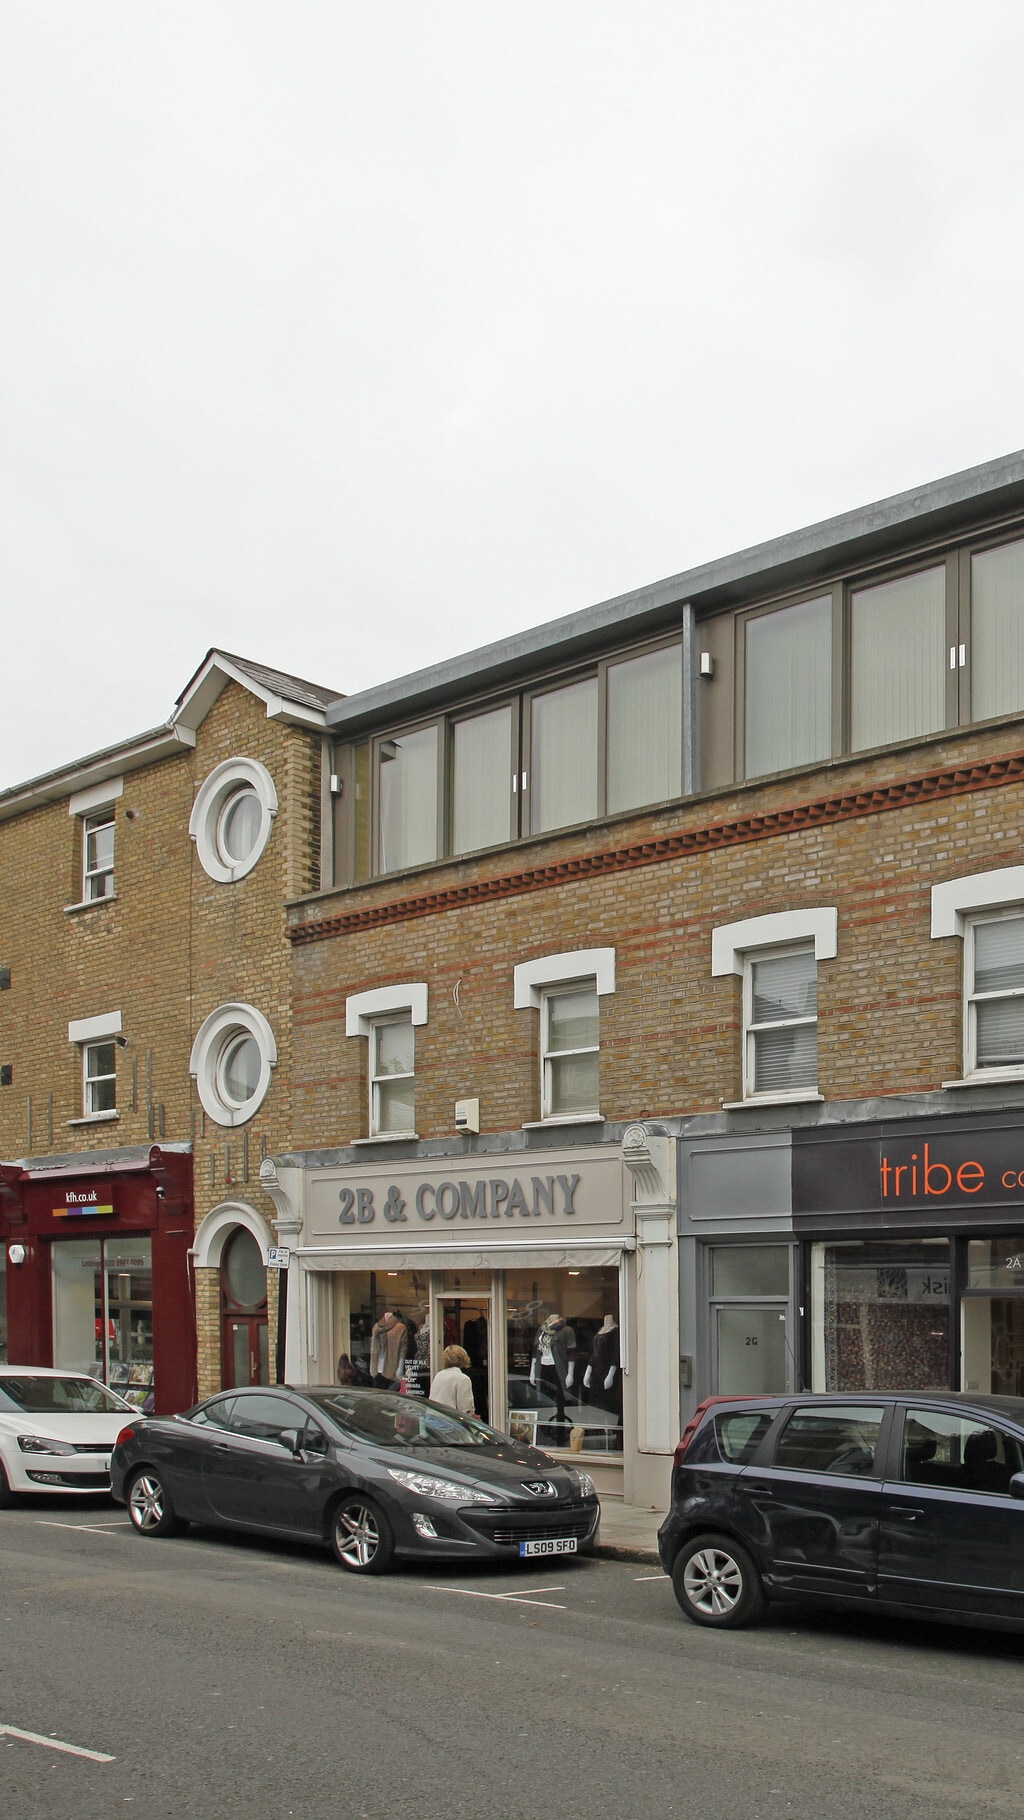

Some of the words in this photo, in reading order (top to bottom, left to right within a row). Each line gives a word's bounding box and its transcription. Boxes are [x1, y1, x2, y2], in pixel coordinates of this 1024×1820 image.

[880, 1143, 985, 1197] tribe
[65, 1190, 98, 1203] kfh.co.uk
[339, 1187, 375, 1224] 2B
[383, 1185, 408, 1222] &
[415, 1174, 581, 1220] COMPANY
[271, 1250, 276, 1259] P
[1005, 1257, 1022, 1269] 2A
[526, 1541, 554, 1555] LS09
